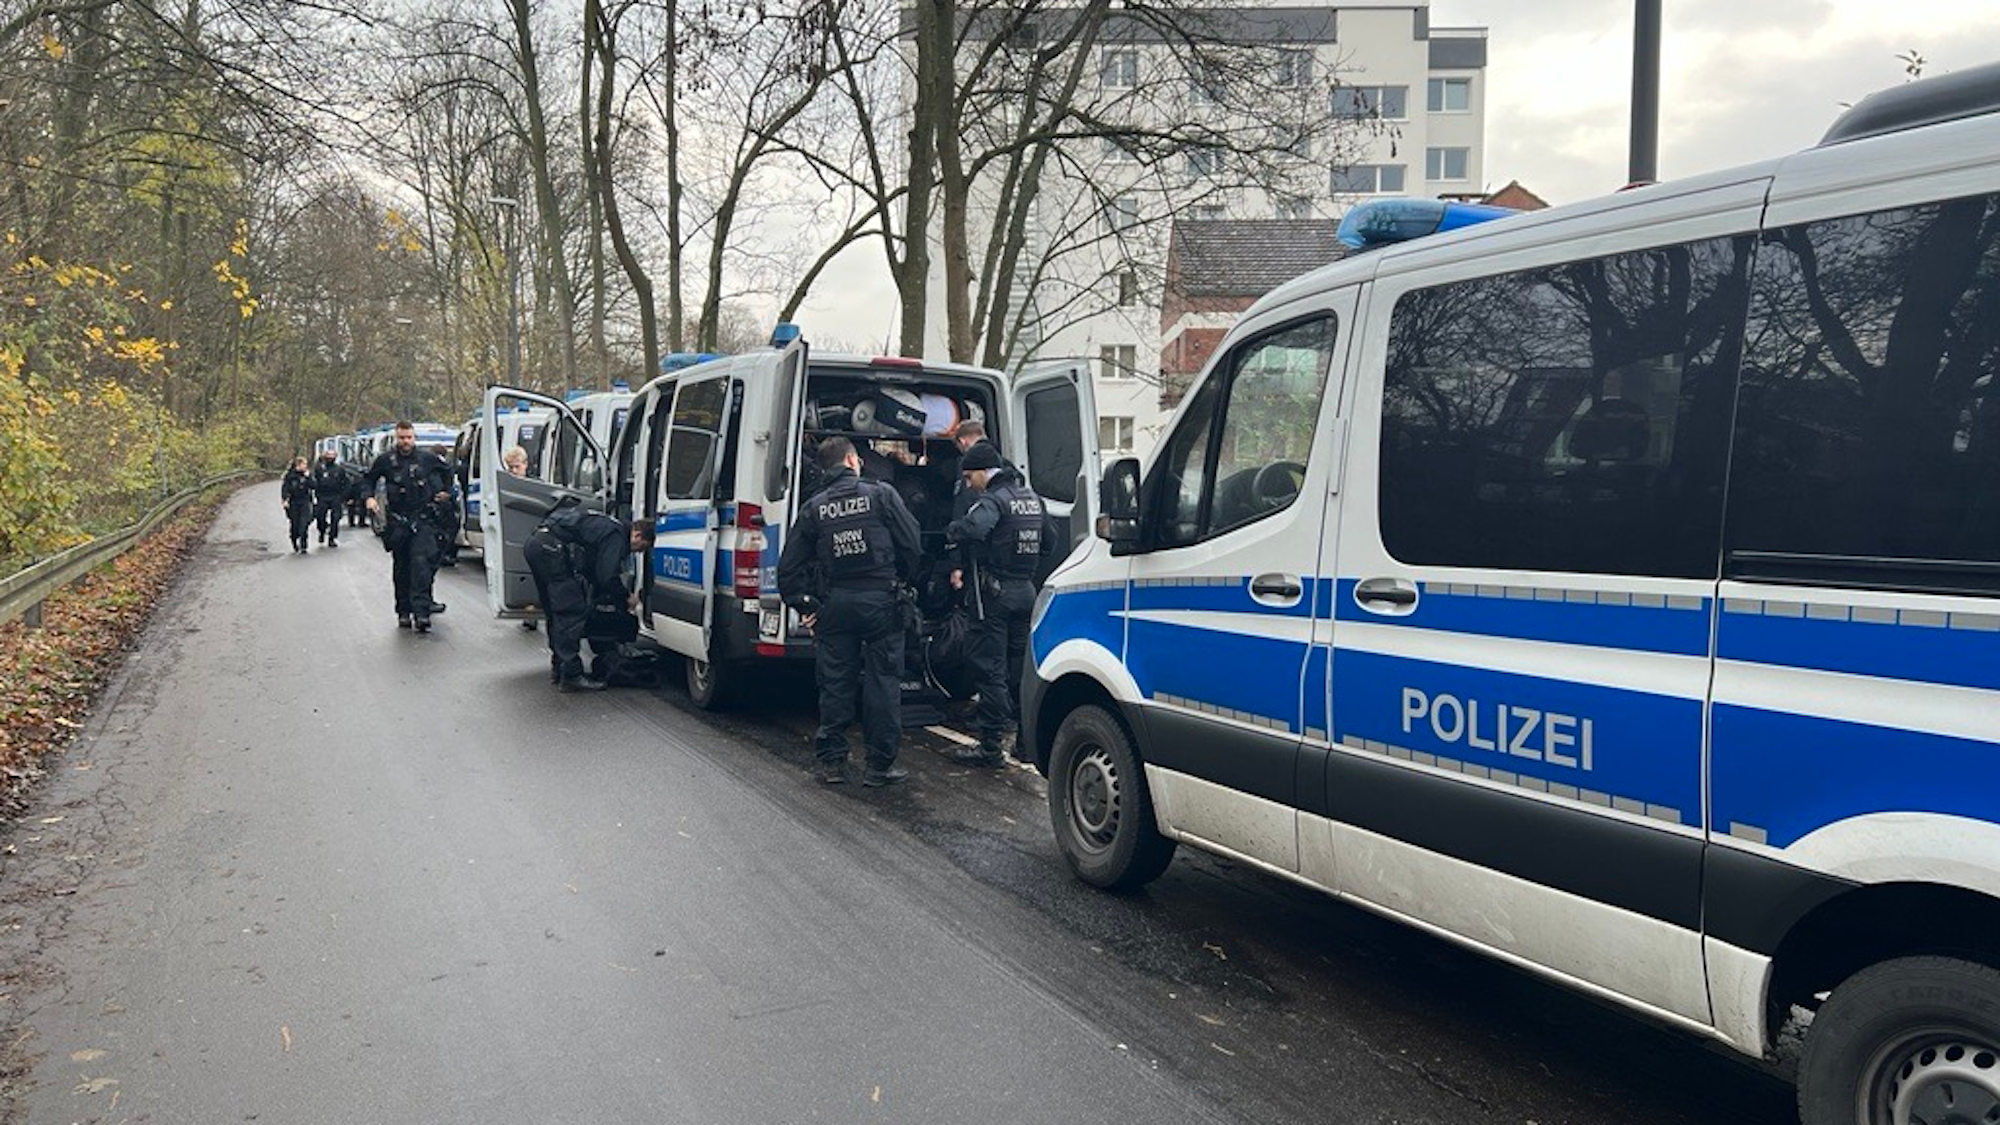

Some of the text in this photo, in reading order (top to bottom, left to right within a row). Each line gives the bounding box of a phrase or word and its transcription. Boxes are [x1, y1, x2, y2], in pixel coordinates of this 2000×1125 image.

[819, 496, 871, 520] POLIZEI
[832, 529, 863, 544] NRW
[663, 554, 690, 579] POLIZEI
[1402, 687, 1593, 771] POLIZEI
